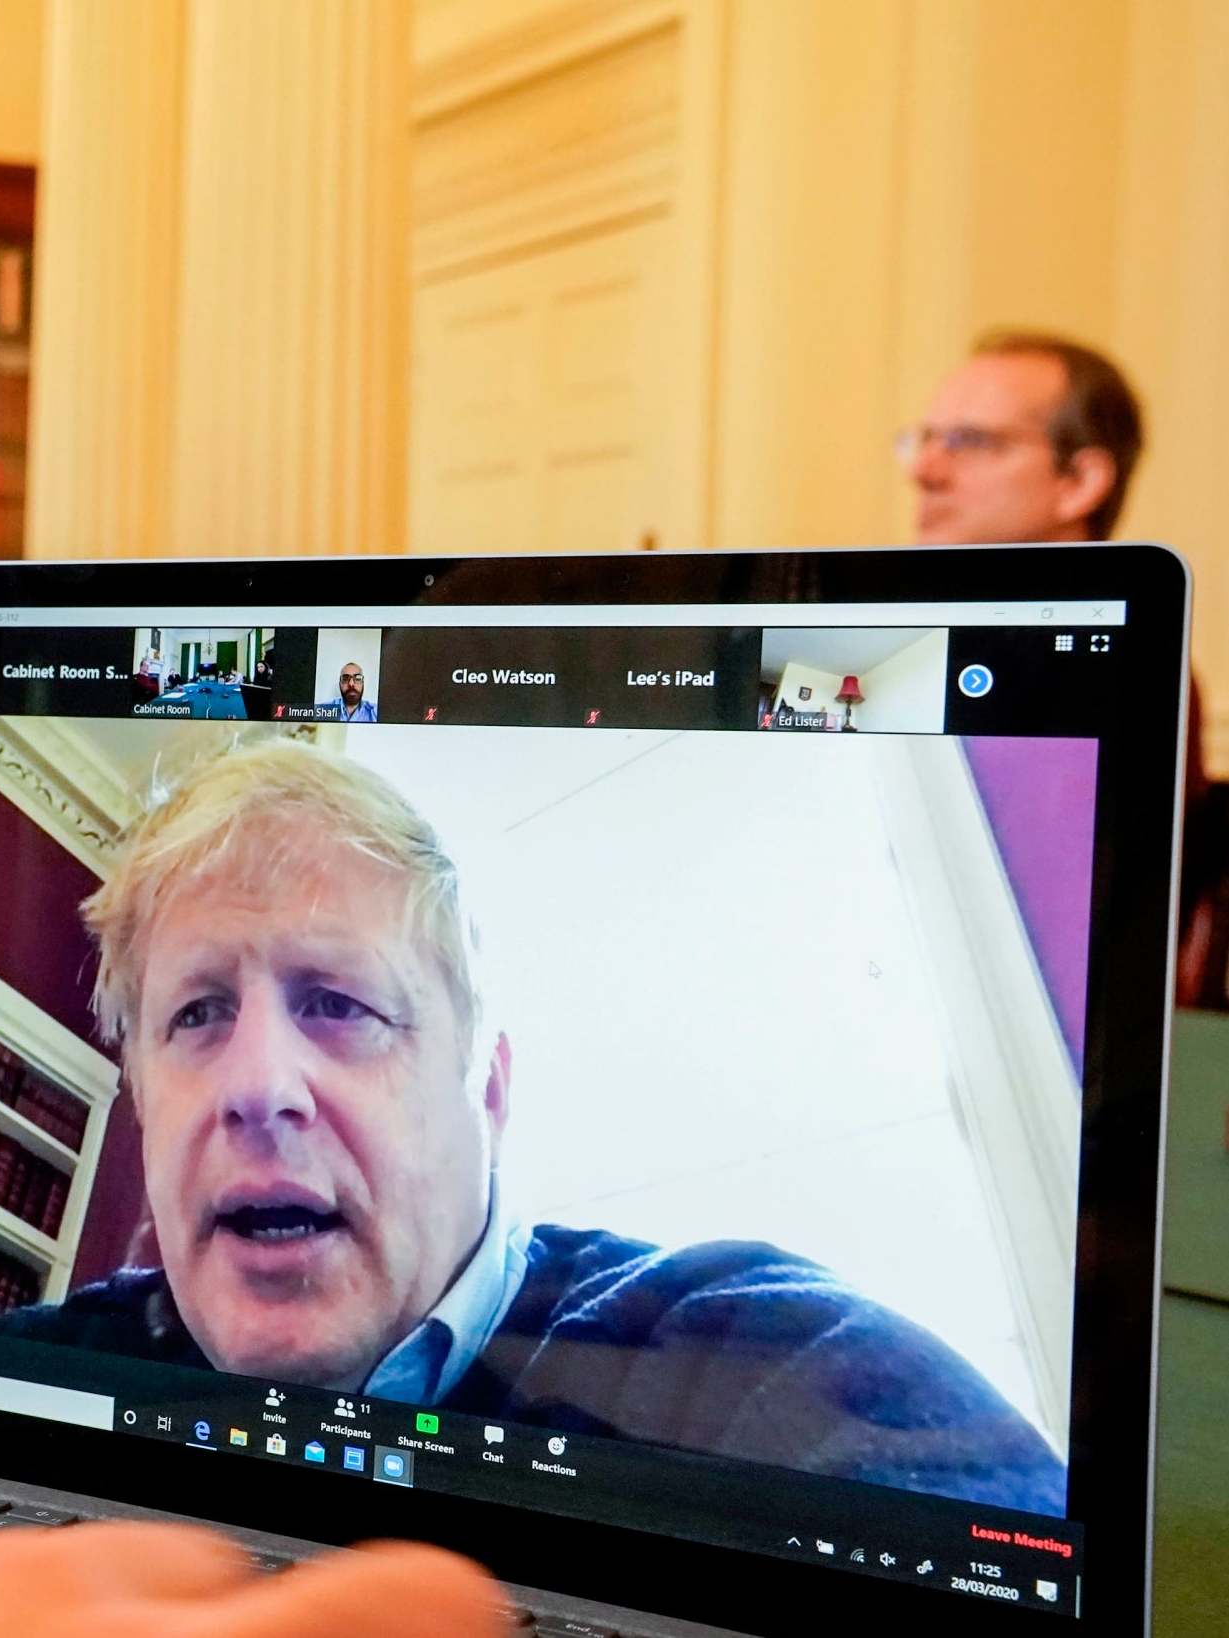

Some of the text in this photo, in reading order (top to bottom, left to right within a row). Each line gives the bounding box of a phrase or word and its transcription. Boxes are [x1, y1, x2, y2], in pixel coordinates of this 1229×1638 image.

[3, 665, 128, 680] Cabinet Room S...
[451, 669, 556, 685] Cleo Watson
[675, 671, 715, 687] iPad
[133, 703, 190, 715] Cabinet Room
[288, 707, 338, 718] Imran Shafi
[778, 716, 824, 728] Ed Lister
[360, 1403, 371, 1415] 11
[262, 1412, 287, 1425] Invite
[320, 1422, 372, 1440] Participants
[397, 1436, 455, 1455] Share Screen
[482, 1451, 504, 1464] Chat
[531, 1460, 577, 1477] Reactions
[971, 1524, 1073, 1557] Leave Meeting
[970, 1561, 1002, 1578] 11:25
[951, 1577, 1019, 1600] 28/03/2020
